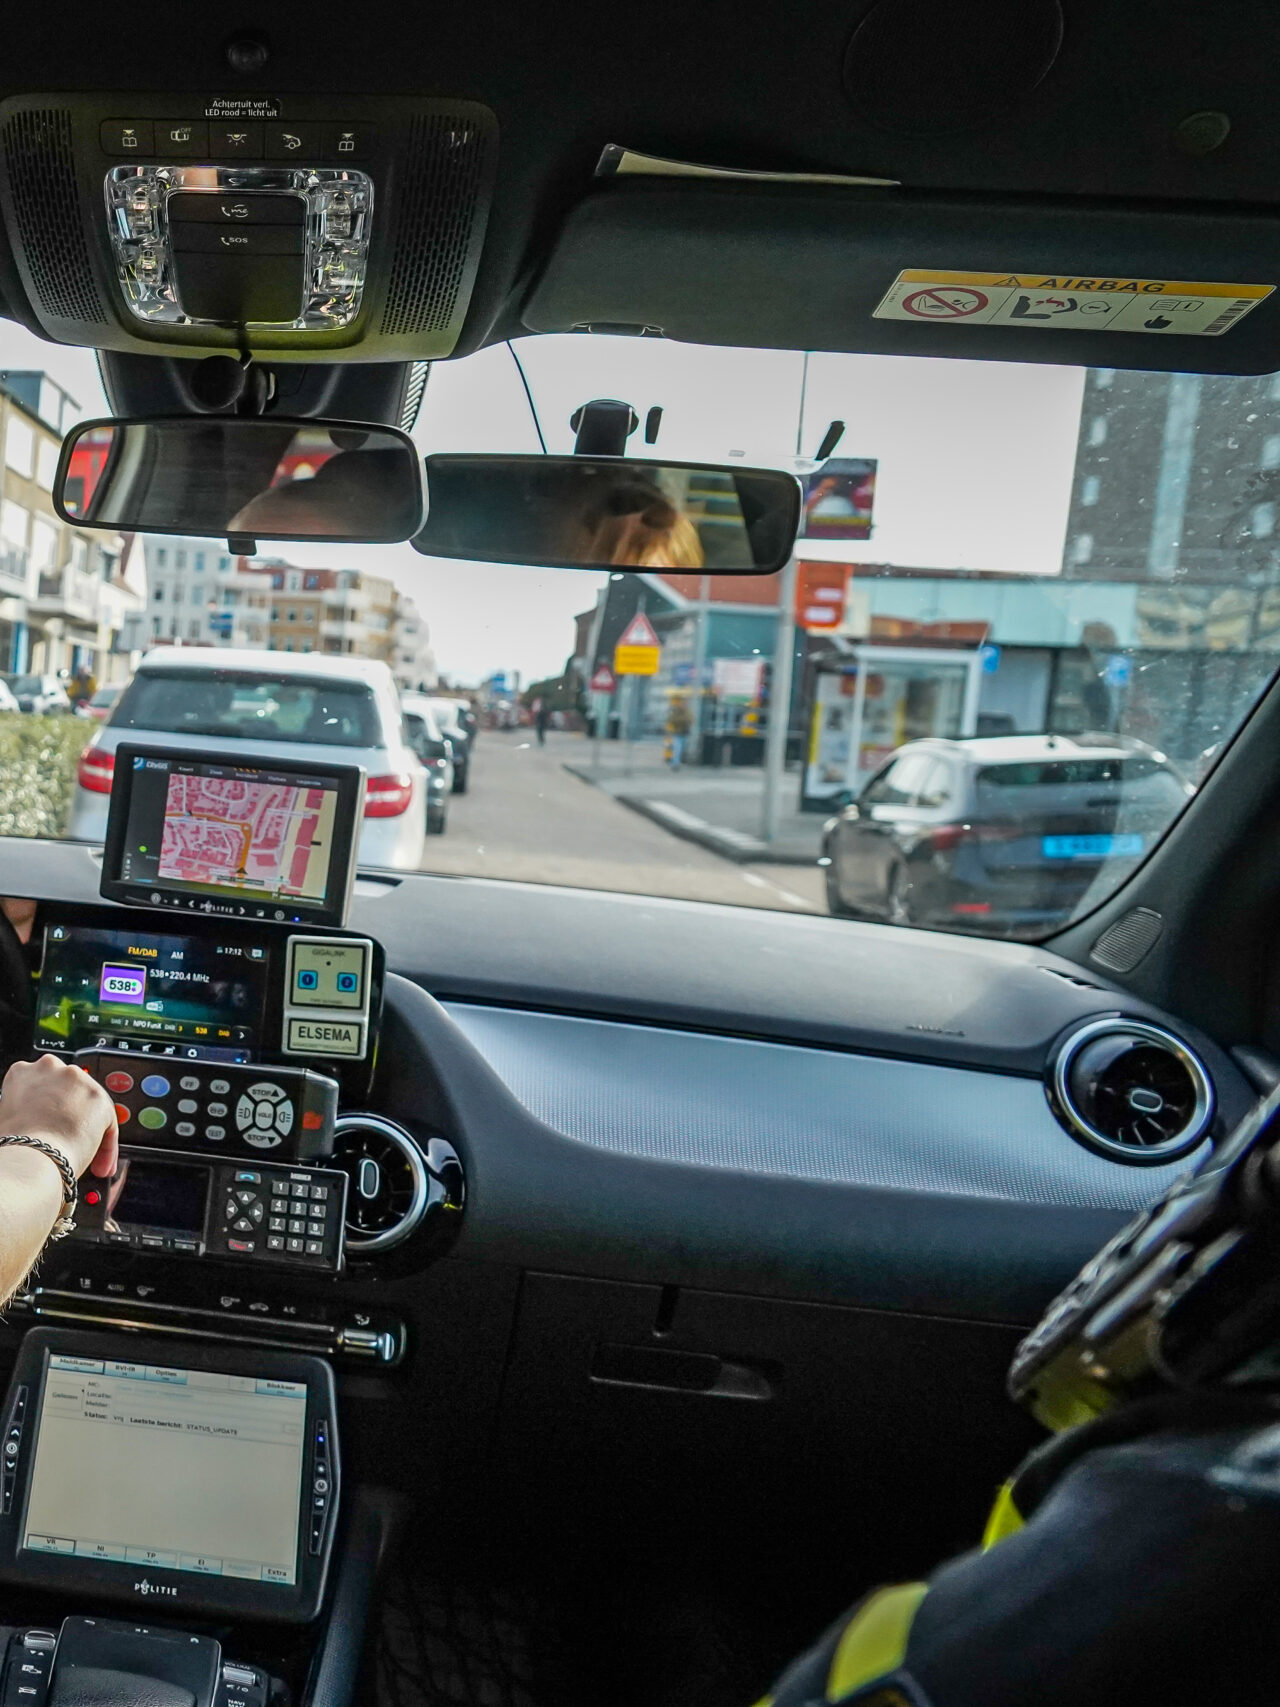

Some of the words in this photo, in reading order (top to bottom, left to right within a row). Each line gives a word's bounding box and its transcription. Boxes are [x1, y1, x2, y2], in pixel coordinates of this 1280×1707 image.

[248, 109, 265, 117] licht
[266, 109, 278, 117] uit
[1037, 278, 1166, 293] AIRBAG
[199, 900, 235, 915] POLITIE
[128, 946, 158, 957] FM/DAB
[170, 951, 184, 960] AM
[224, 947, 242, 956] 17:12
[192, 973, 210, 983] MHz
[109, 980, 131, 992] 538
[88, 1015, 100, 1023] JOE
[298, 1026, 352, 1042] ELSEMA
[247, 1134, 267, 1142] STOP
[267, 1568, 287, 1577] Extra
[134, 1579, 177, 1596] POLITIE
